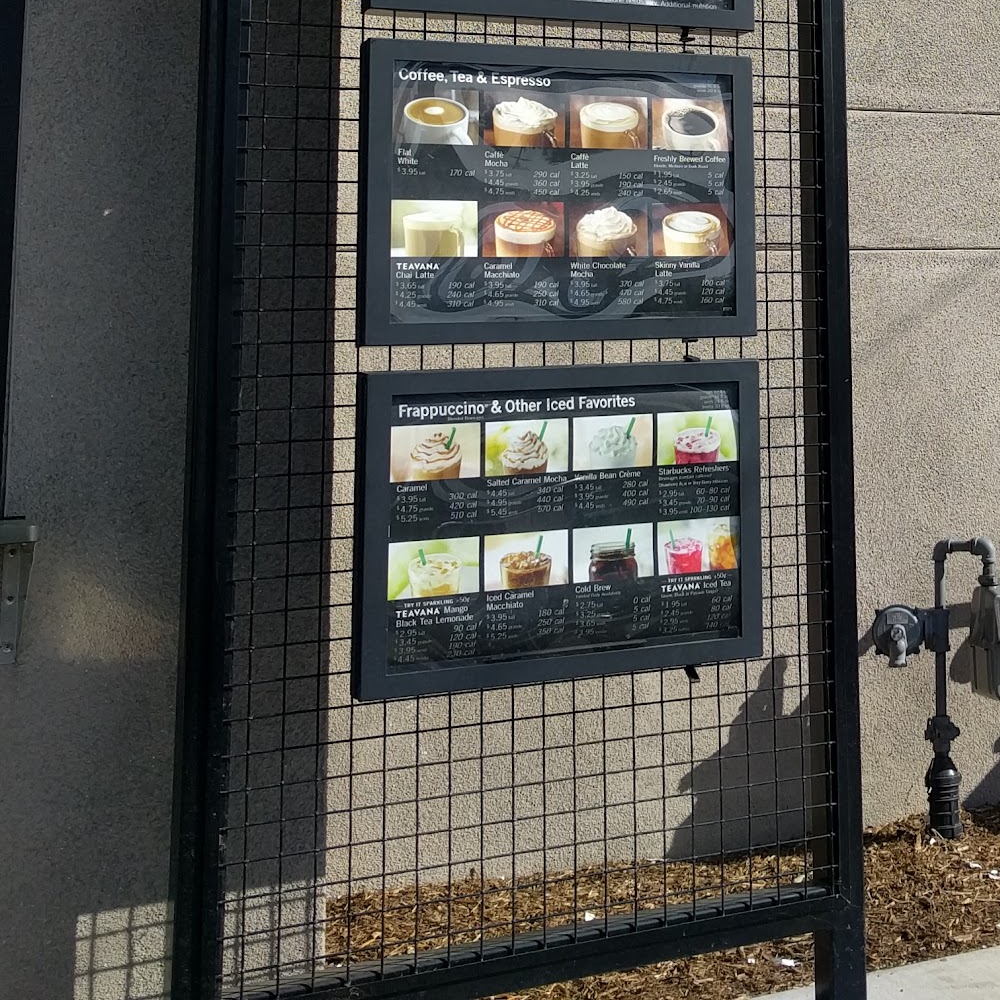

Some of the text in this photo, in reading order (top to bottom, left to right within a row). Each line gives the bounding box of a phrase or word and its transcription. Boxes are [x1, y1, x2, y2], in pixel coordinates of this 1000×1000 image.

[398, 67, 551, 87] Coffee, Tea & Espresso
[397, 148, 412, 156] Flat
[484, 150, 504, 158] Caffè
[397, 156, 419, 165] White
[570, 153, 589, 161] Caffè
[654, 155, 677, 164] Freshly
[484, 159, 508, 167] Mocha
[633, 172, 644, 180] cal
[484, 262, 513, 270] Caramel
[570, 262, 590, 270] White
[655, 261, 700, 270] Skinny Vanilla
[396, 271, 434, 279] Chai Latte
[484, 271, 520, 279] Macchiato
[570, 270, 594, 278] Mocha
[634, 280, 645, 288] cal
[398, 395, 636, 420] Frappuccino & Other Iced Favorites
[658, 467, 692, 476] Starbucks
[694, 464, 730, 473] Refreshers
[574, 469, 641, 482] Vanilla Bean Crème
[486, 476, 567, 488] Salted Caramel Mocha
[638, 479, 649, 487] cal
[396, 484, 428, 493] Caramel
[575, 584, 611, 594] Cold Brew
[661, 582, 700, 593] TEAVANA
[720, 579, 731, 587] Tea
[486, 591, 534, 602] Iced Caramel
[487, 602, 524, 611] Macchiato
[396, 606, 469, 618] TEAVANA Mango
[396, 614, 474, 628] Black Tea Lemonade
